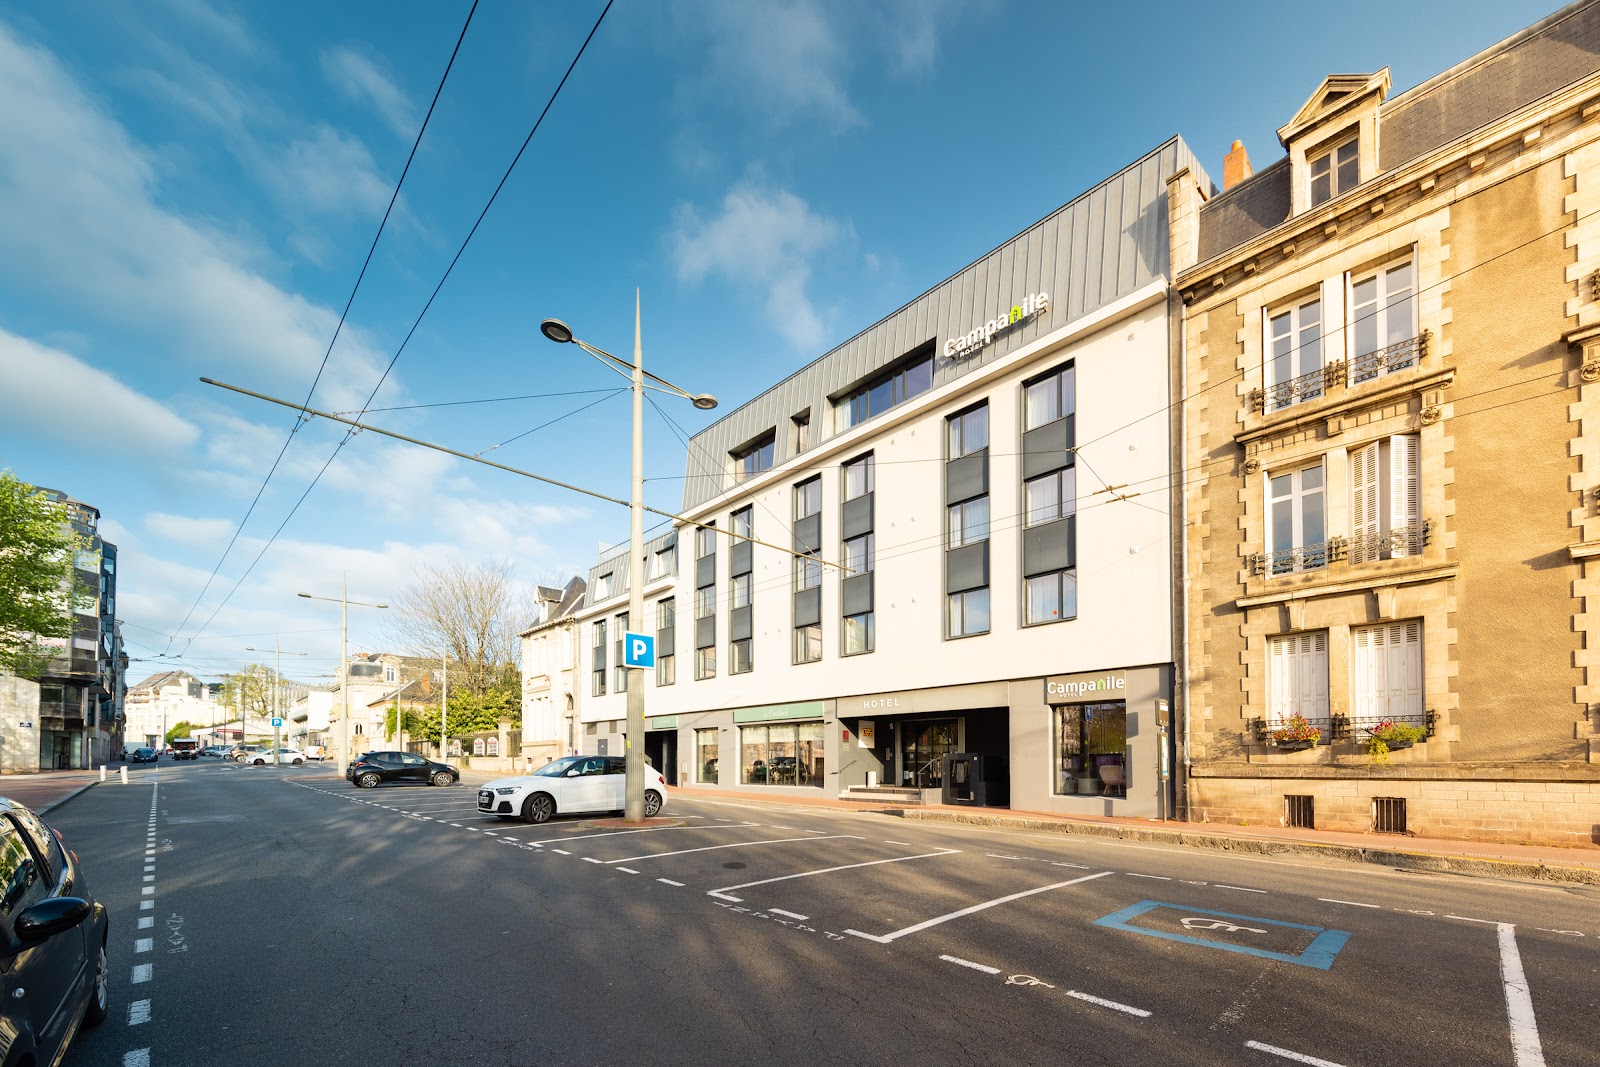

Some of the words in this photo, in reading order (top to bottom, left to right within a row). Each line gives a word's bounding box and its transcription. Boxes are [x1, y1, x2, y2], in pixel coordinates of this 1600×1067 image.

[943, 291, 1049, 358] Campanile
[632, 639, 647, 661] P
[1047, 675, 1125, 697] Campanile
[863, 697, 900, 709] HOTEL
